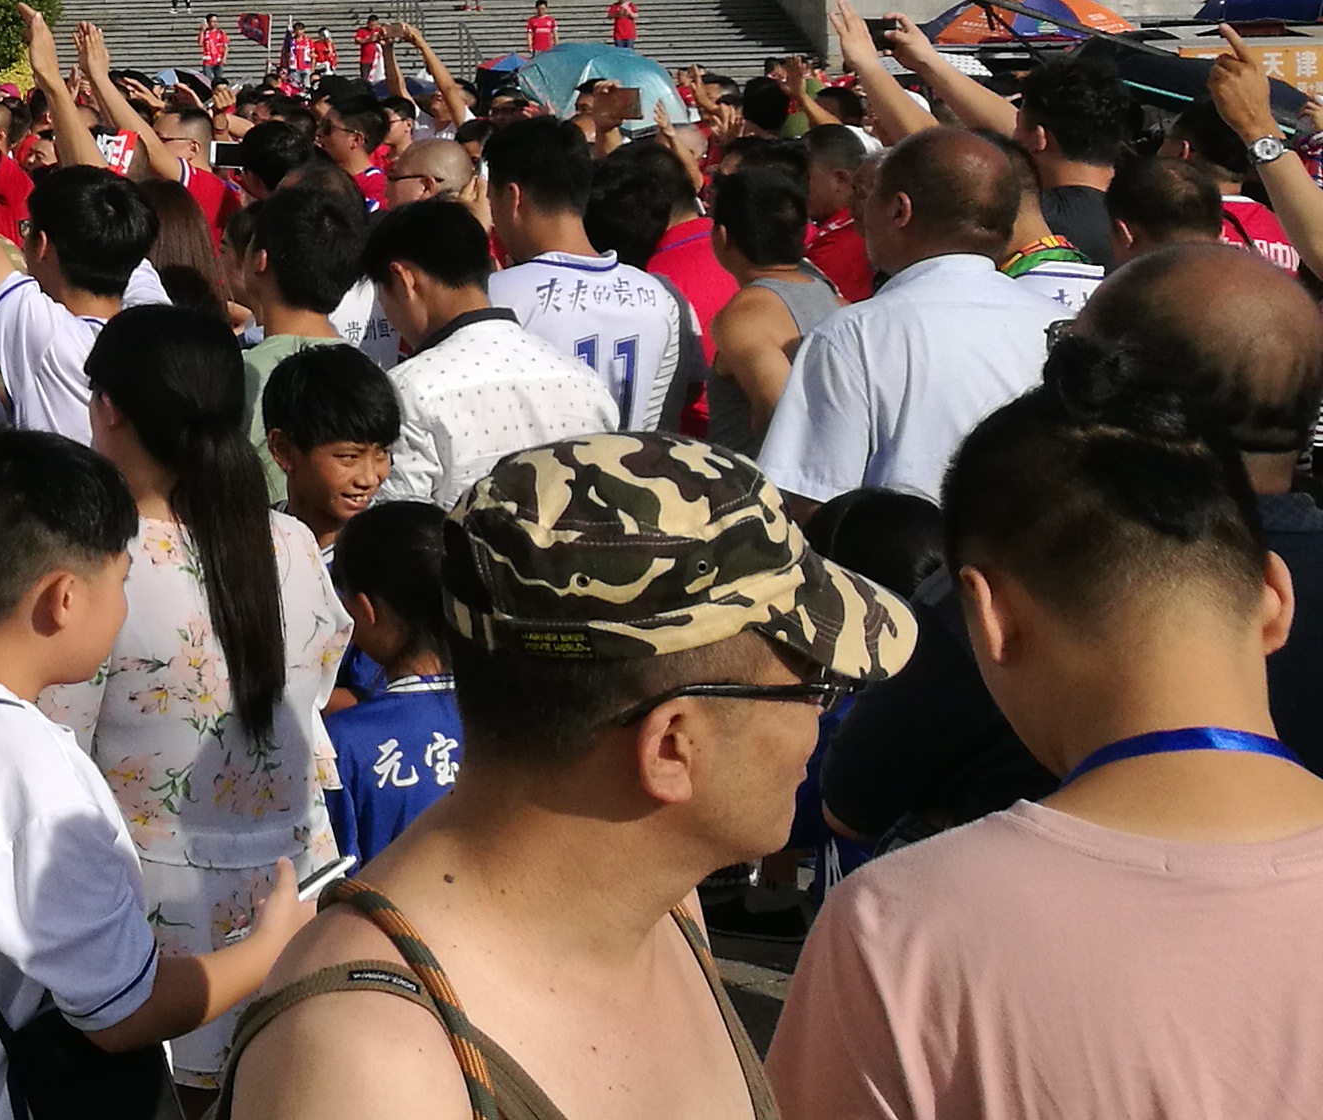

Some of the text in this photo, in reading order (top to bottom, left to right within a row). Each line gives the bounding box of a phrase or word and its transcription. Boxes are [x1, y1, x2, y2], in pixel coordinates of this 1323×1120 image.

[536, 277, 656, 315] 爽爽的贵阳
[345, 318, 395, 343] 贵州恒
[374, 732, 460, 789] 元宝
